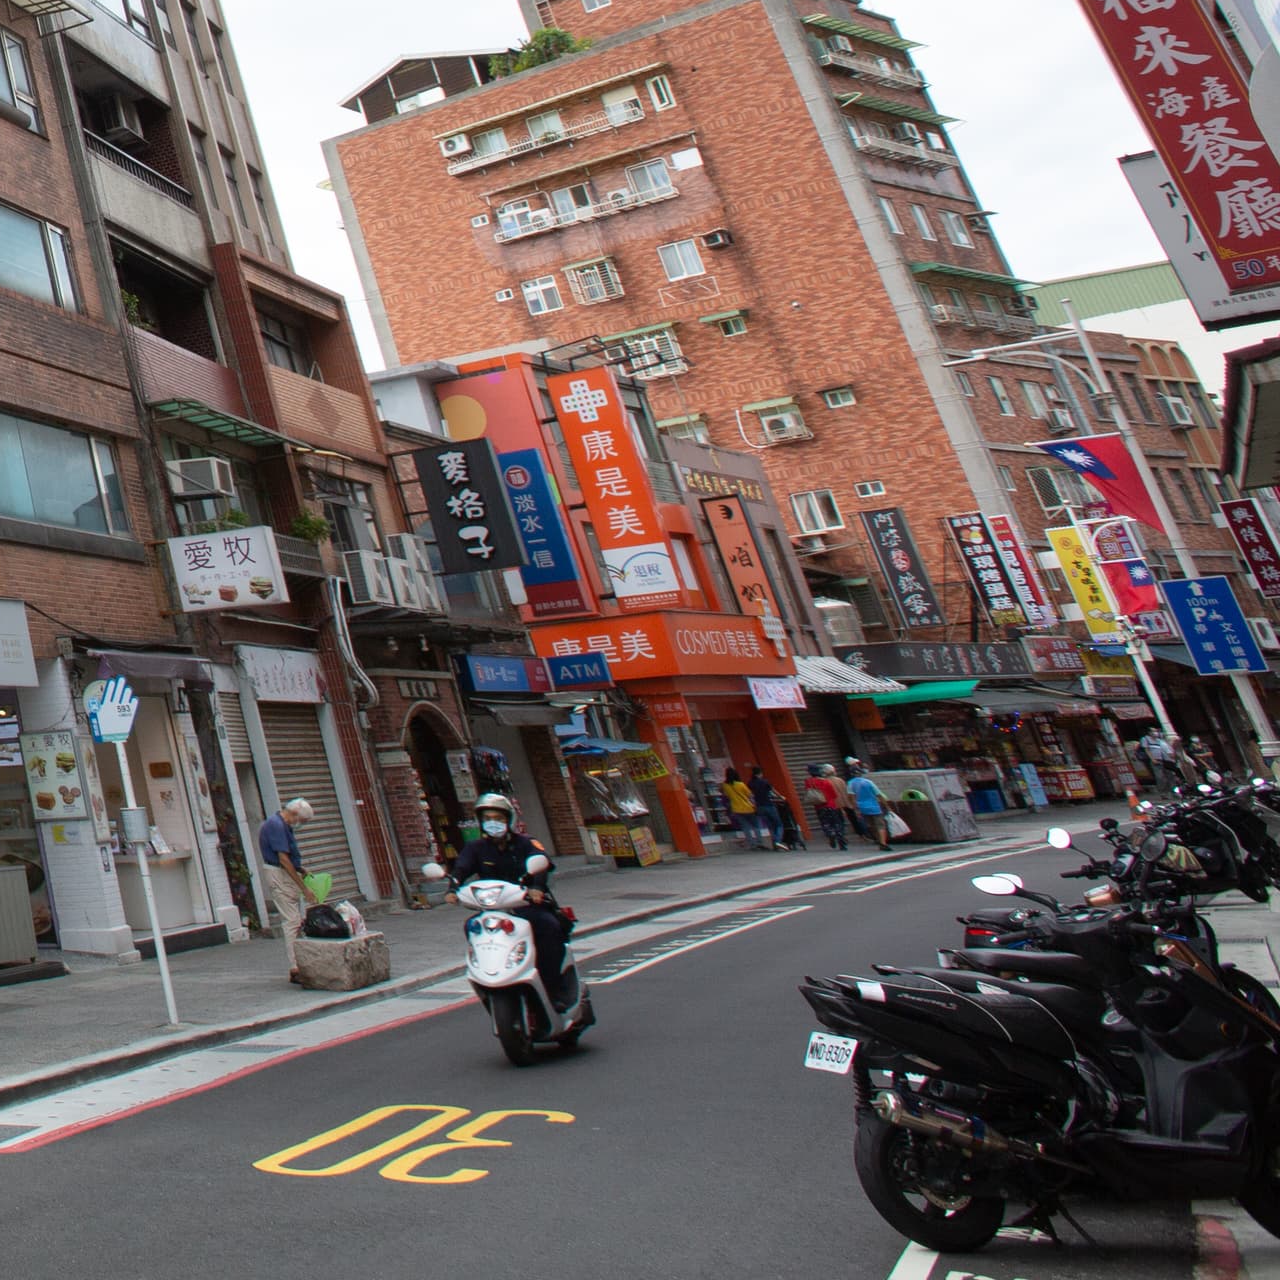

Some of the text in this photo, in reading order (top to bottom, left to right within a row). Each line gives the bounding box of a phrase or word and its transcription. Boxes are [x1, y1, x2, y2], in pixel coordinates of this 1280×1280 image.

[581, 429, 646, 540] 康是美
[437, 451, 495, 559] 麥格子
[513, 493, 556, 570] 淡水一信
[184, 536, 257, 572] 愛牧
[971, 554, 1015, 610] 現烤蛋糕
[1186, 596, 1219, 608] 100m
[1192, 607, 1207, 623] P
[551, 629, 657, 664] 康是美
[560, 662, 601, 680] ATM
